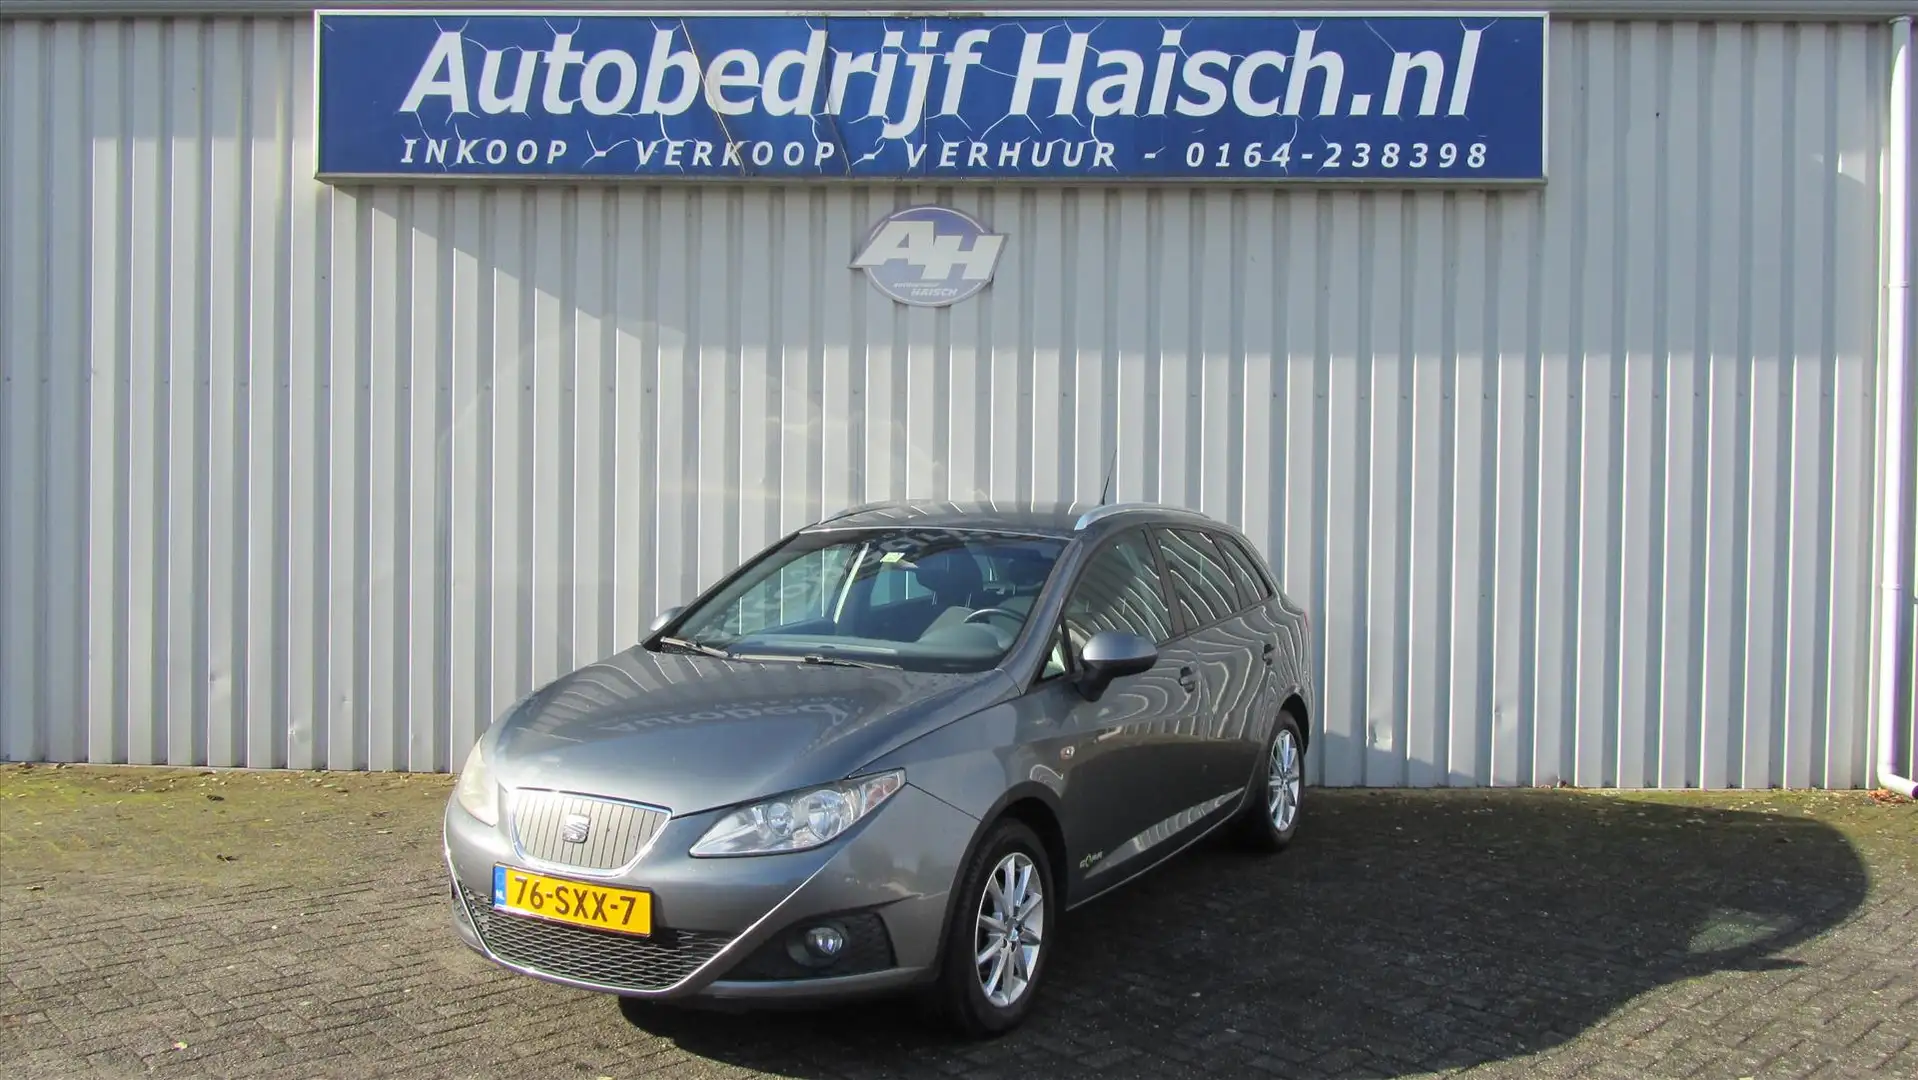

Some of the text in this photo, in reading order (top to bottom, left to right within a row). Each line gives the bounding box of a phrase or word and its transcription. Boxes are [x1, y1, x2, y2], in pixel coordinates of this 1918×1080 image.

[399, 29, 1482, 139] Autobedrijf Haisch.nl
[400, 139, 567, 165] INKOOP
[636, 141, 835, 167] VERKOOP
[906, 142, 1115, 168] VERHUUR
[1185, 142, 1487, 168] 0164-238398
[855, 220, 1004, 280] AH
[910, 288, 958, 297] HAISCH
[514, 877, 637, 925] 76-SXX-7
